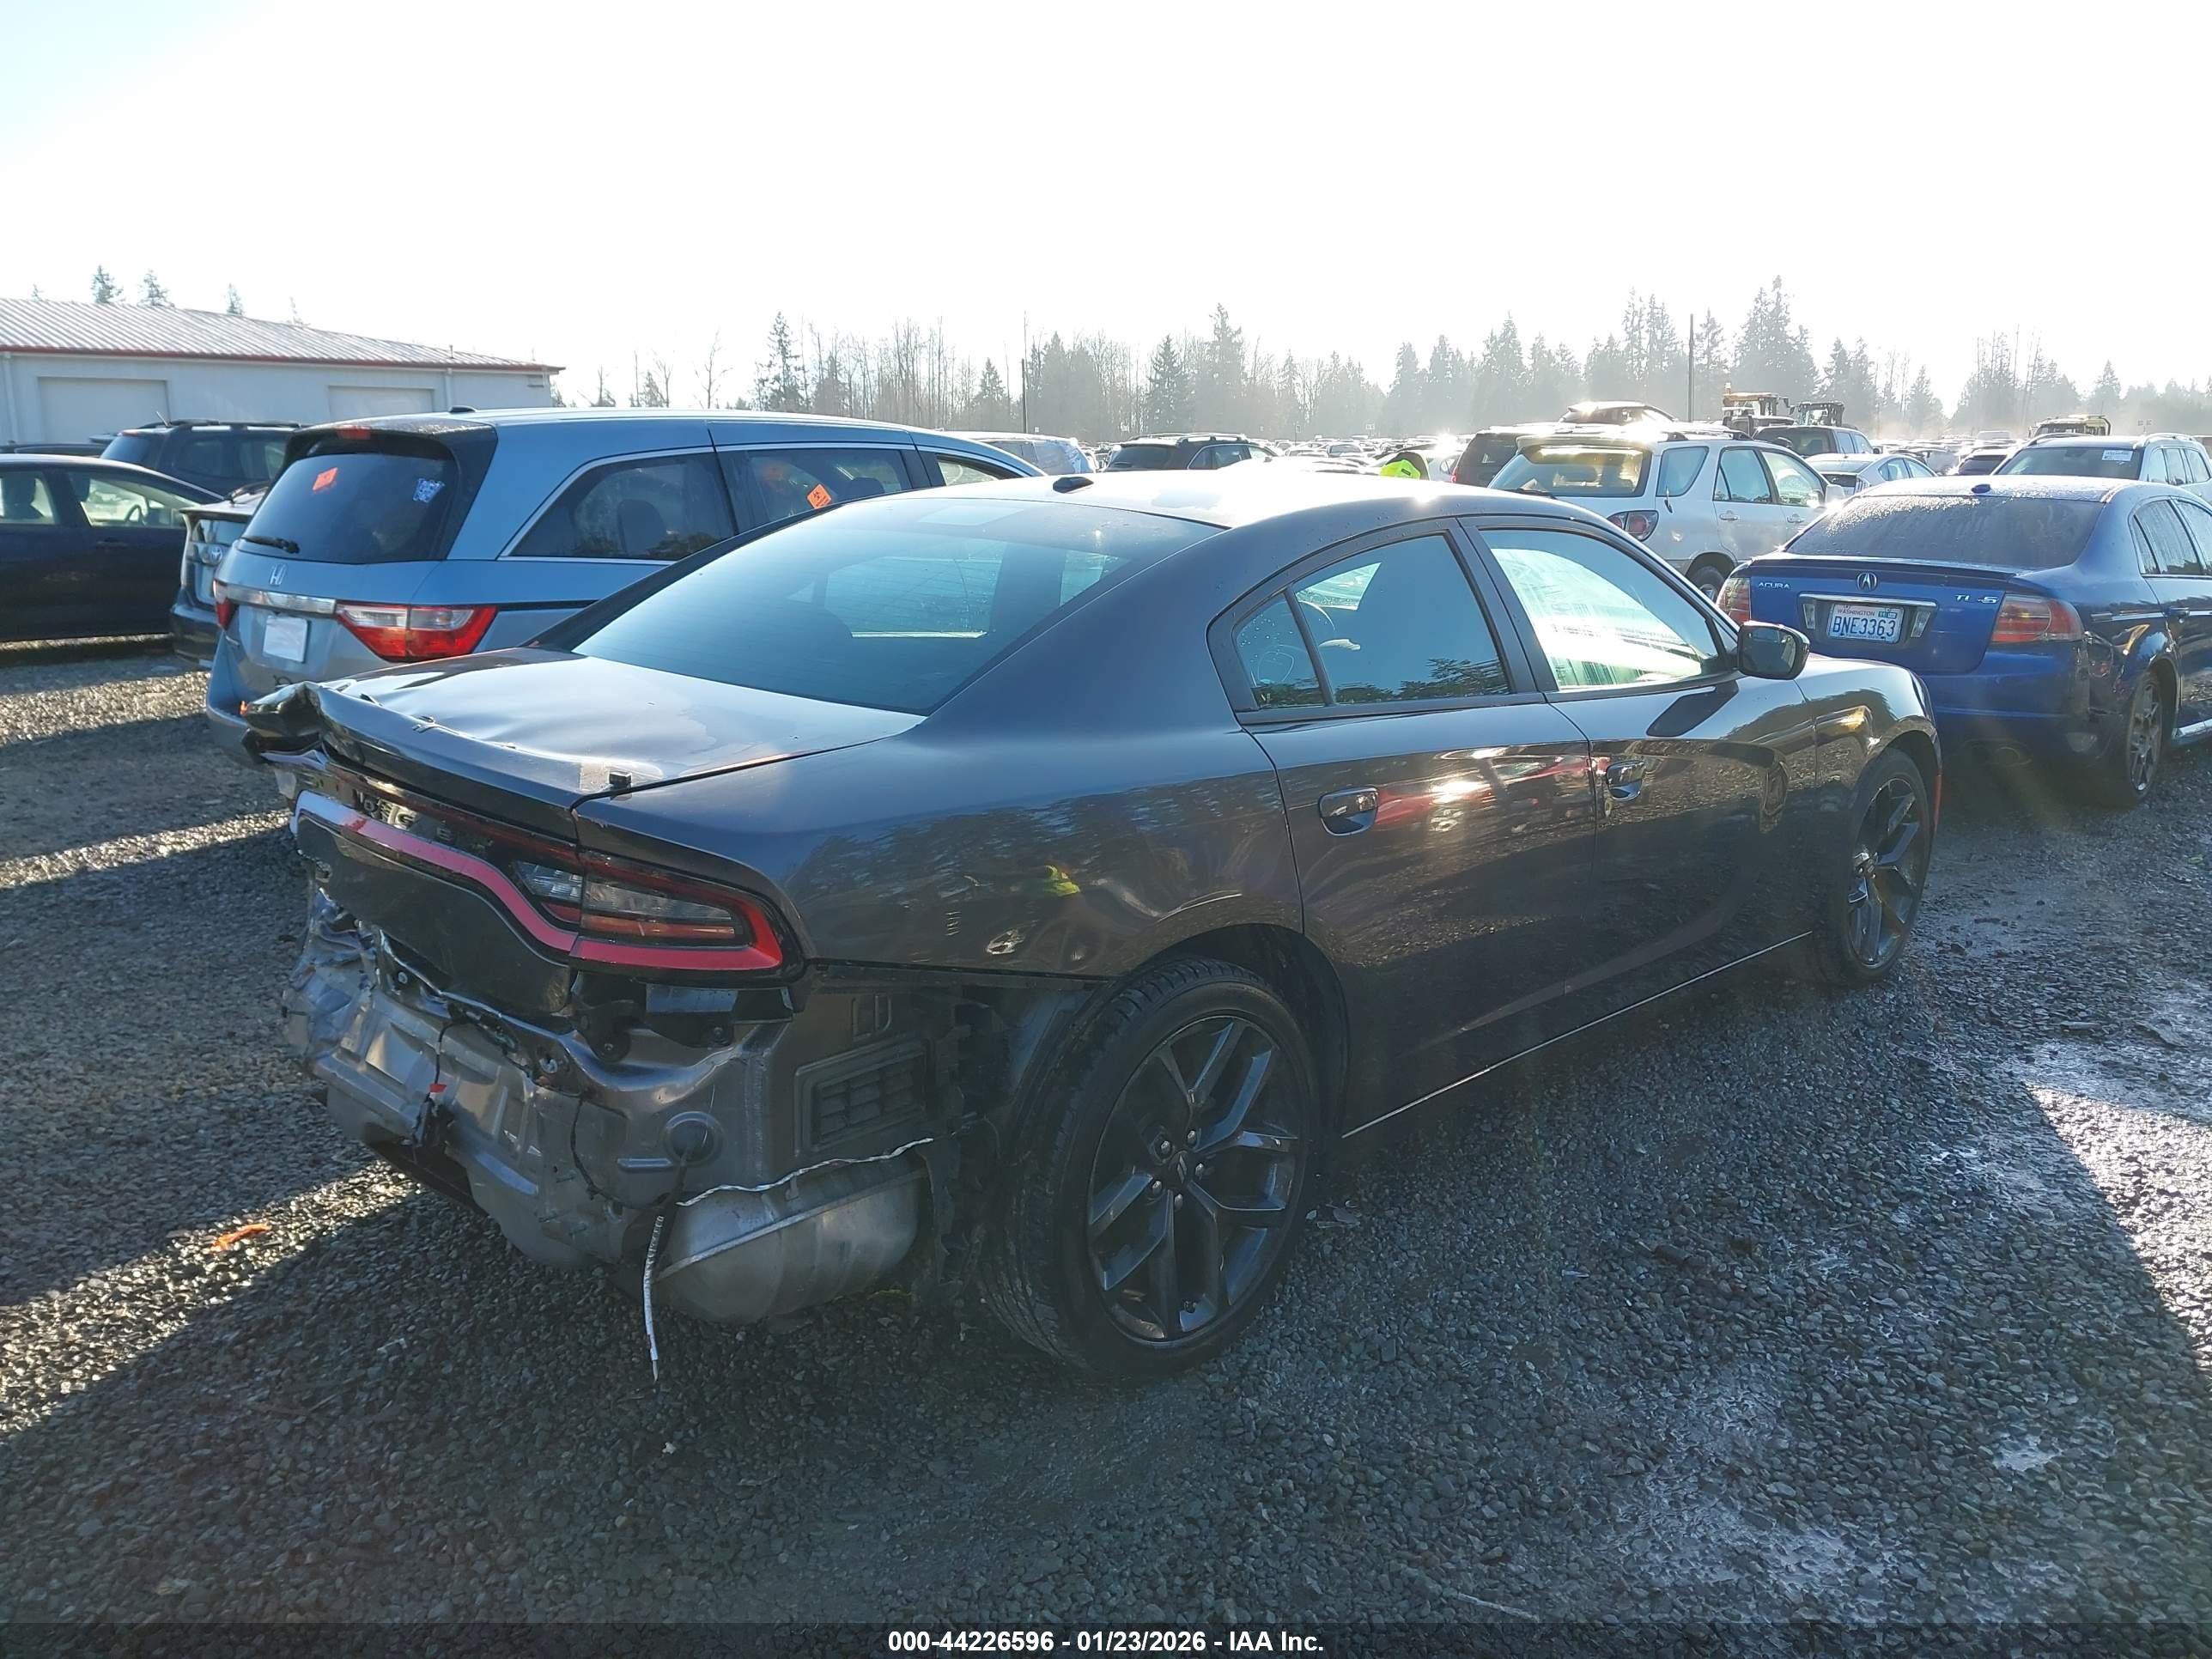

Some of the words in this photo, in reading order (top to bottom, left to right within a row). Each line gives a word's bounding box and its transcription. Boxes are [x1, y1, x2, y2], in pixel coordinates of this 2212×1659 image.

[1758, 581, 1790, 590] ACURA
[1838, 607, 1875, 617] WASHINGTON
[1832, 616, 1896, 637] BNE3363
